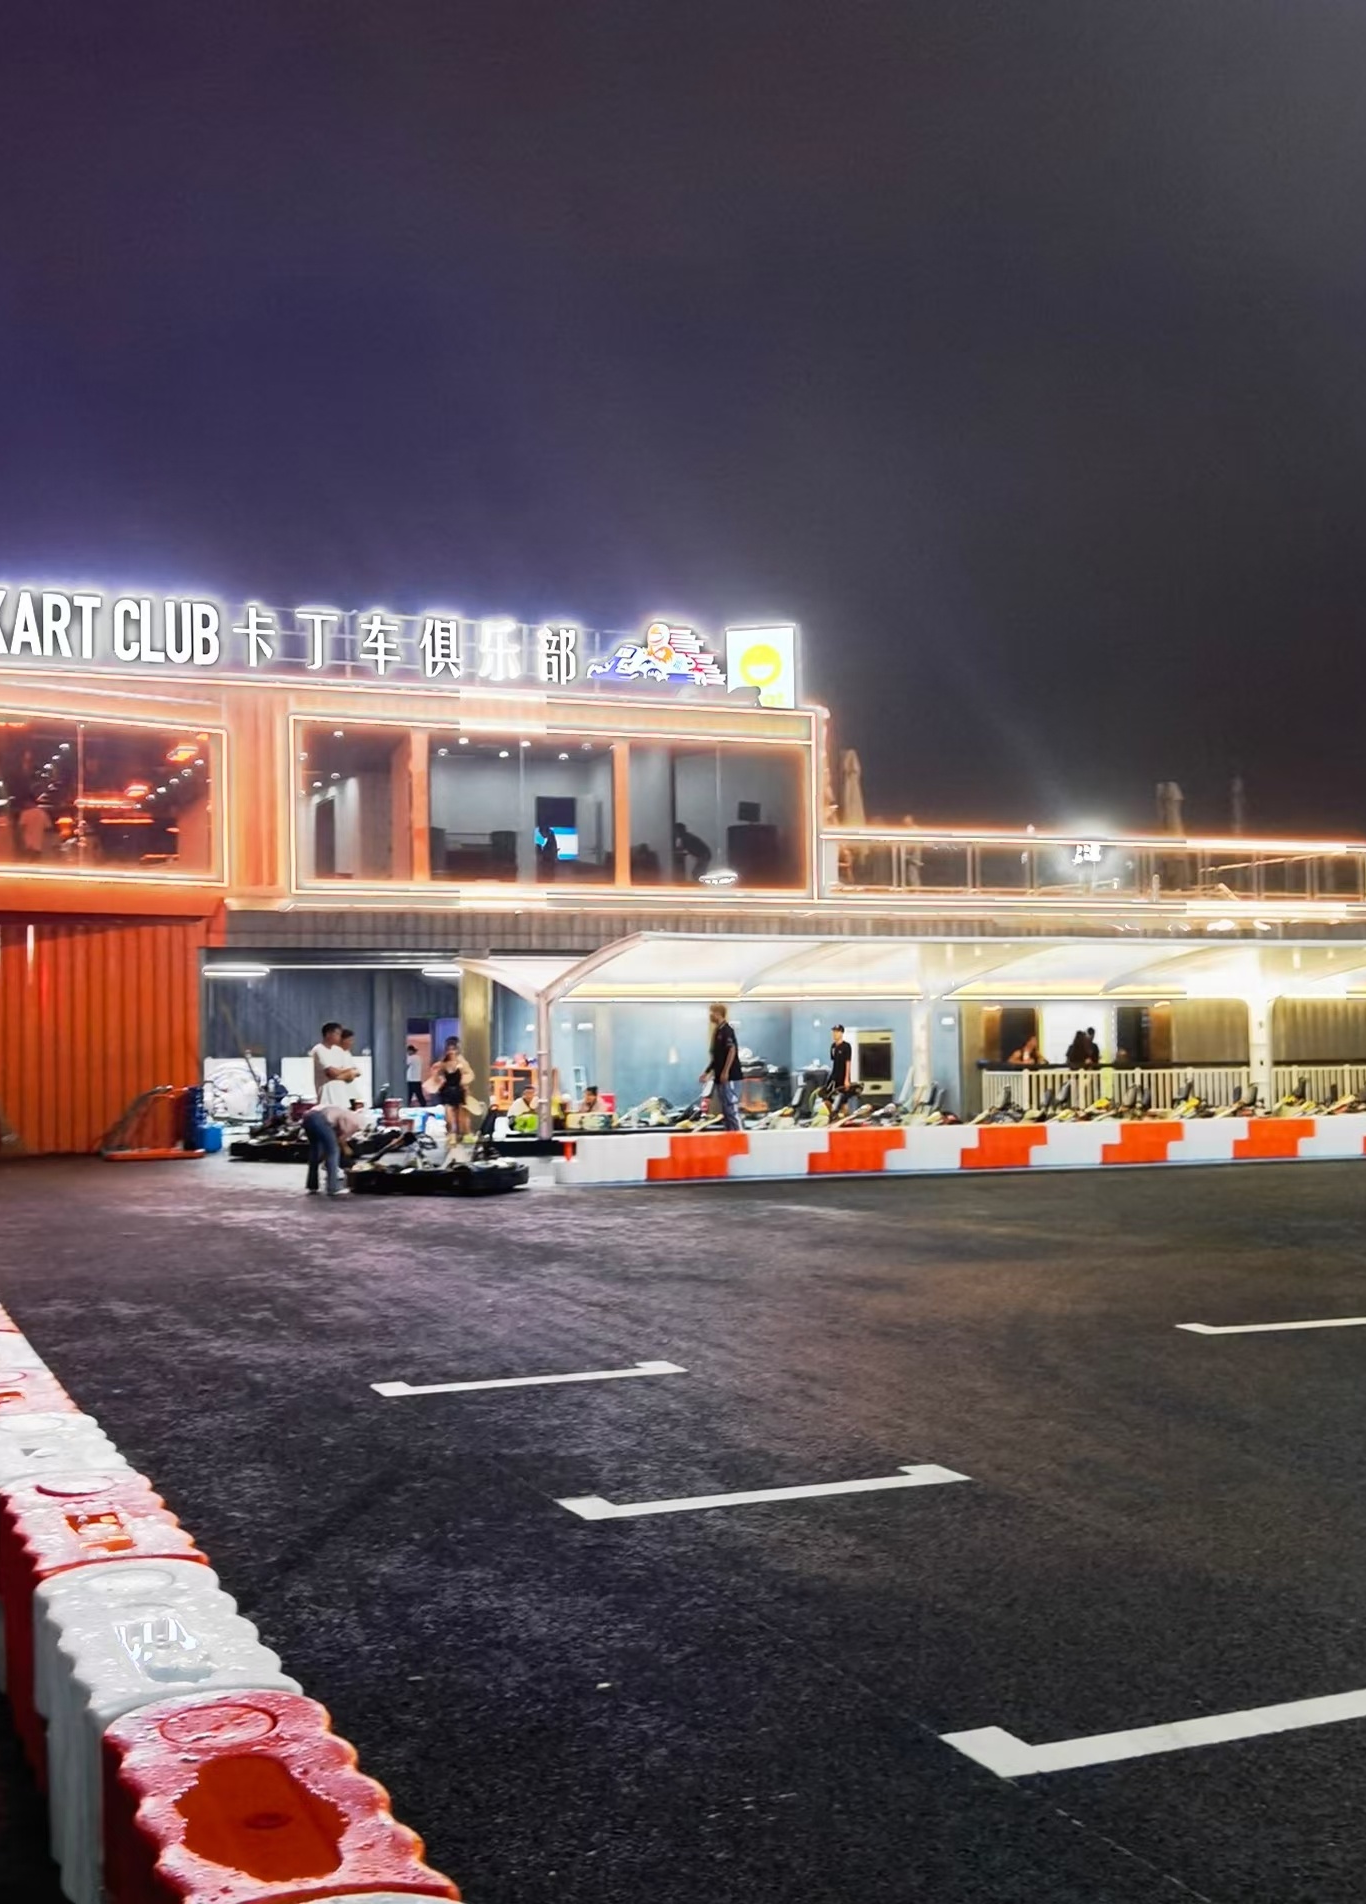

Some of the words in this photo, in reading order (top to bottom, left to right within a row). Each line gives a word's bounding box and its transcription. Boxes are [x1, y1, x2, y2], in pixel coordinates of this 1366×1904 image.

[114, 599, 220, 666] CLUB
[232, 604, 578, 685] 卡丁车俱乐部
